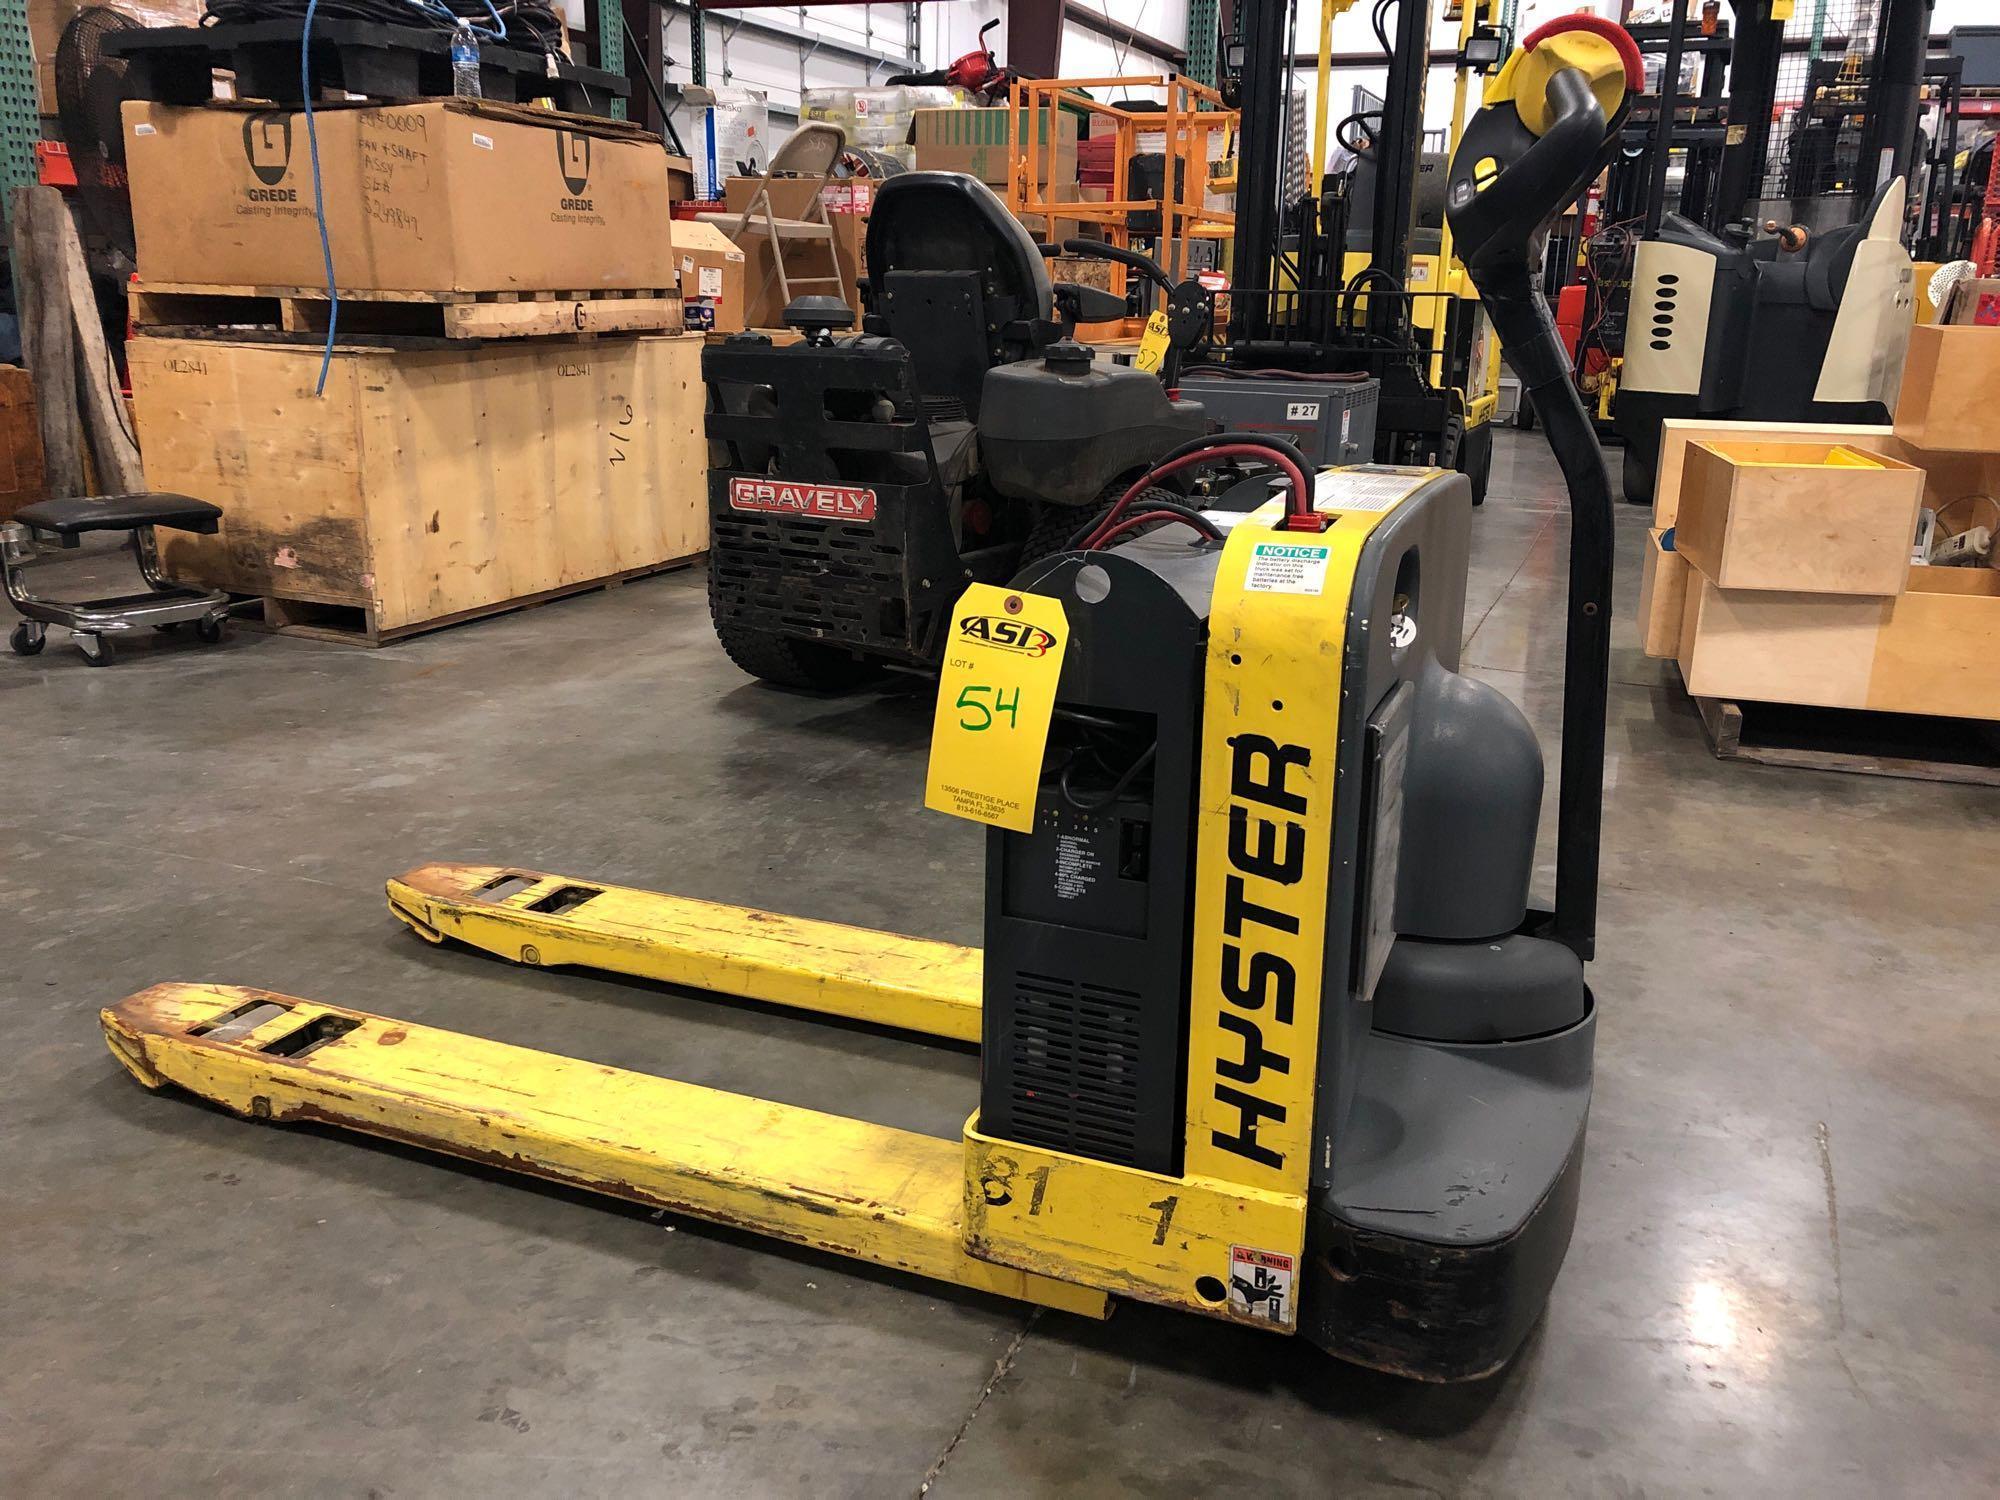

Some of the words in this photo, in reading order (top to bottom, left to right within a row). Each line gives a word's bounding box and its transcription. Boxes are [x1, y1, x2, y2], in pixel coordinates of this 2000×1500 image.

[249, 189, 297, 202] GREDE
[236, 204, 272, 217] Casting
[274, 206, 314, 218] Integrity
[560, 198, 594, 211] GREDE
[550, 212, 576, 225] Casting
[577, 214, 603, 226] Integrity
[557, 364, 592, 377] OL2841
[1302, 405, 1317, 416] 27
[735, 483, 871, 515] GRAVELY
[1262, 546, 1321, 558] NOTICE
[950, 659, 967, 668] LOT
[956, 685, 1020, 731] 54
[953, 795, 976, 807] TAMPA
[976, 801, 984, 809] FL
[960, 788, 995, 804] PRESTIGE
[996, 799, 1020, 810] PLACE
[1211, 733, 1311, 1170] HYSTER
